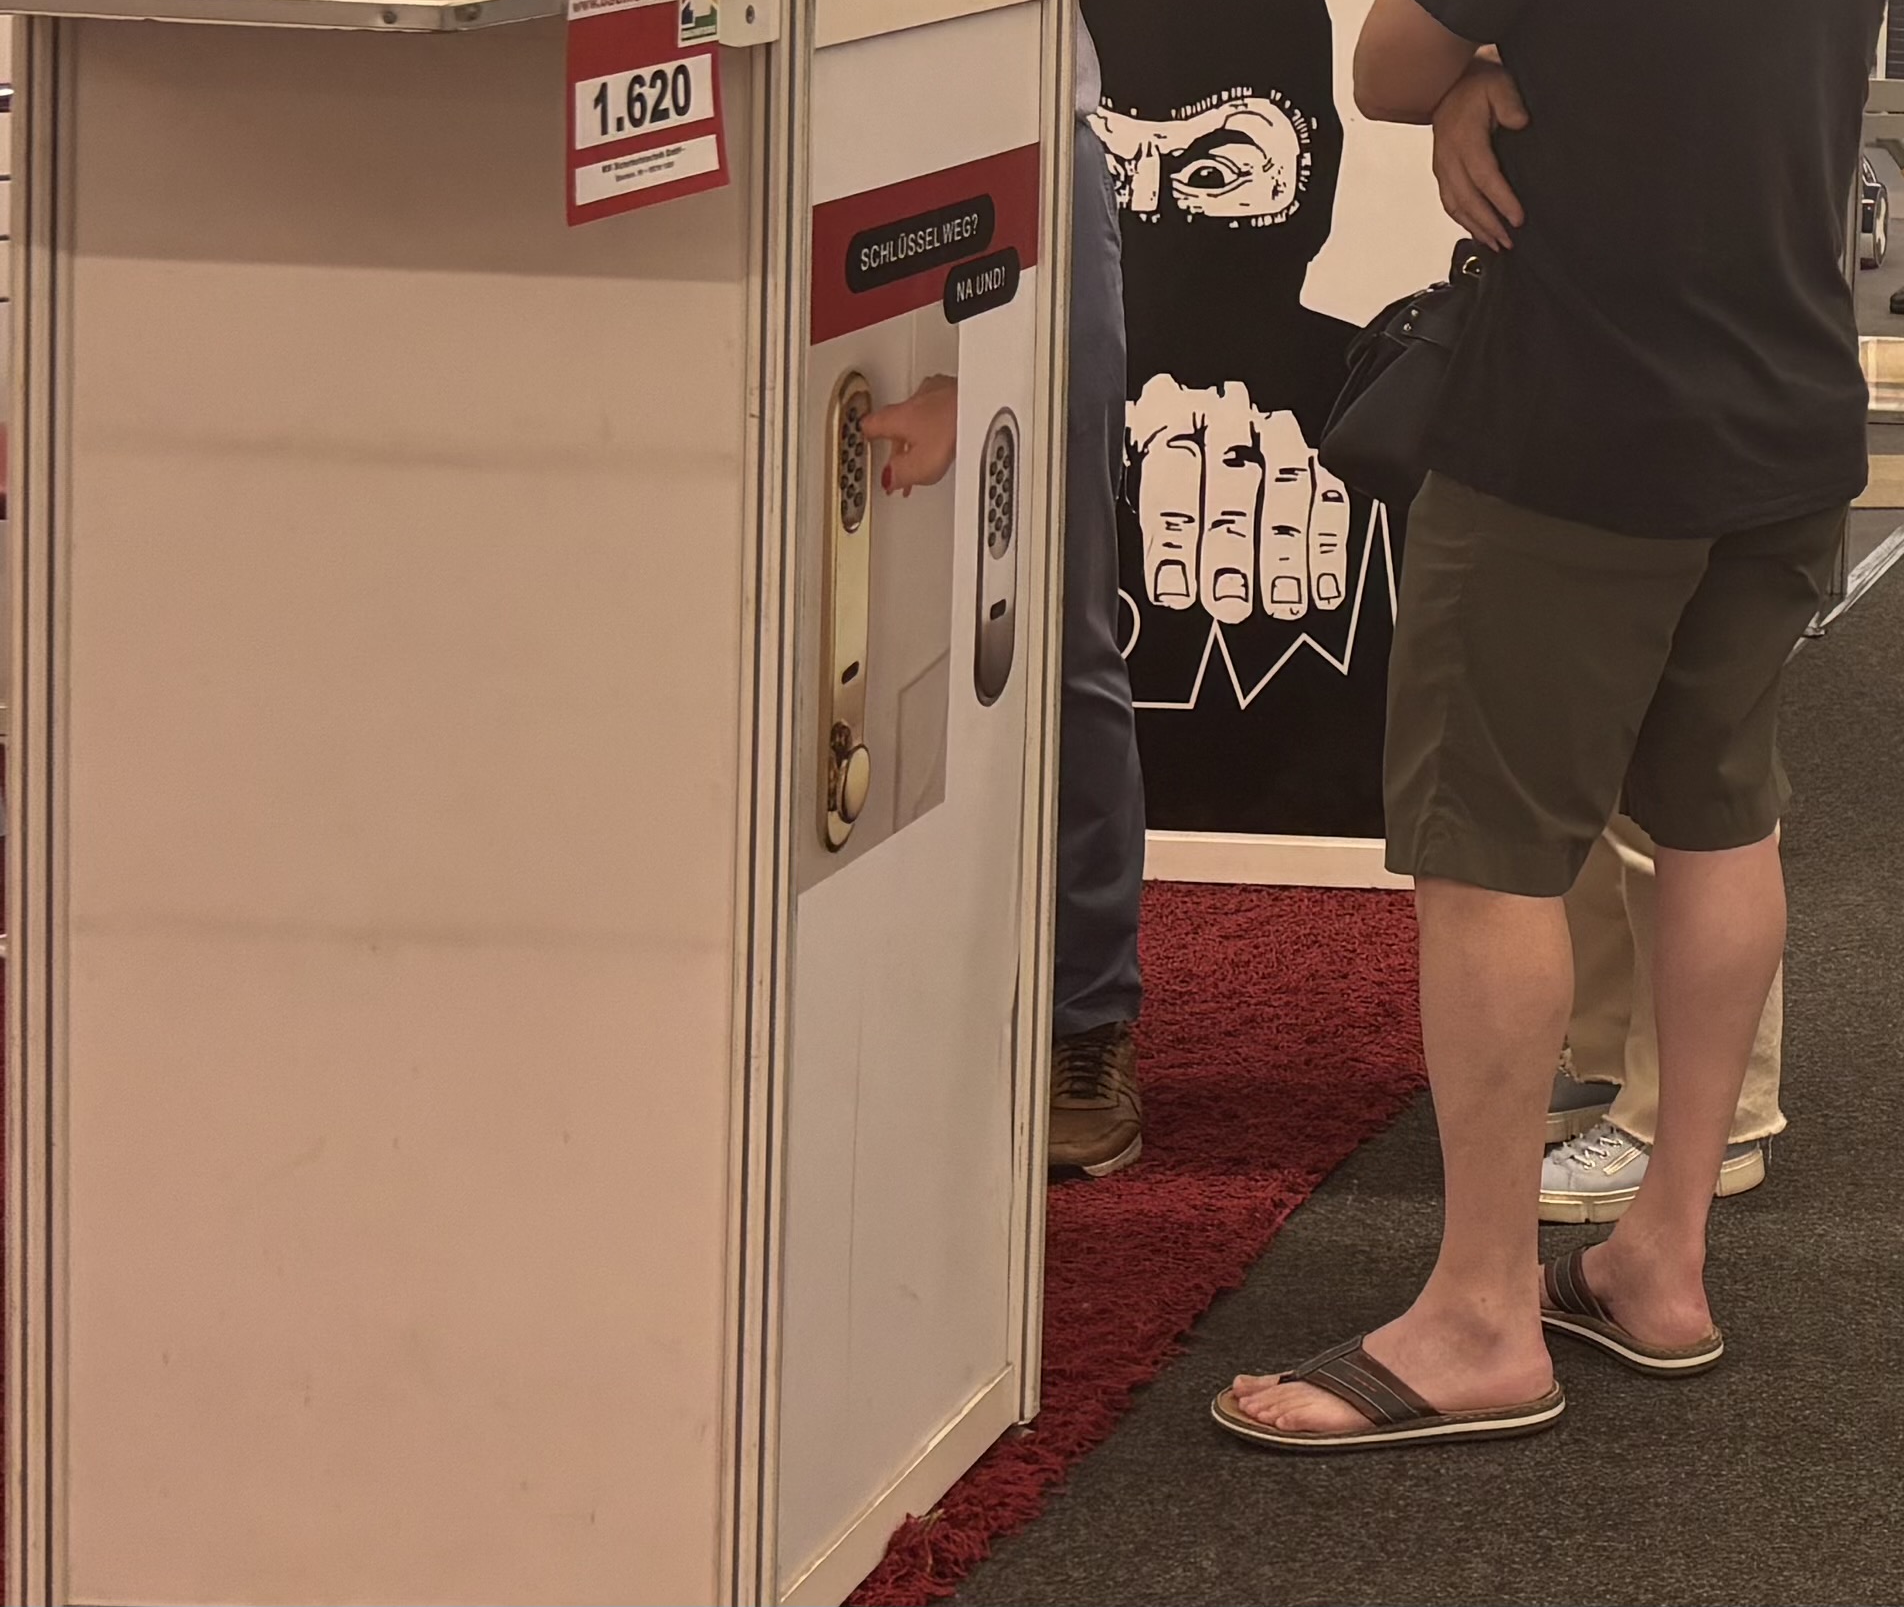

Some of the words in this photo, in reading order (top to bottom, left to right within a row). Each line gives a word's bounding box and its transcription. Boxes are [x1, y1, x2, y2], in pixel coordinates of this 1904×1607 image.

[593, 63, 692, 137] 1.620
[860, 227, 942, 272] SCHLÜSSEL
[942, 213, 979, 243] WEG?
[956, 279, 975, 303] NA
